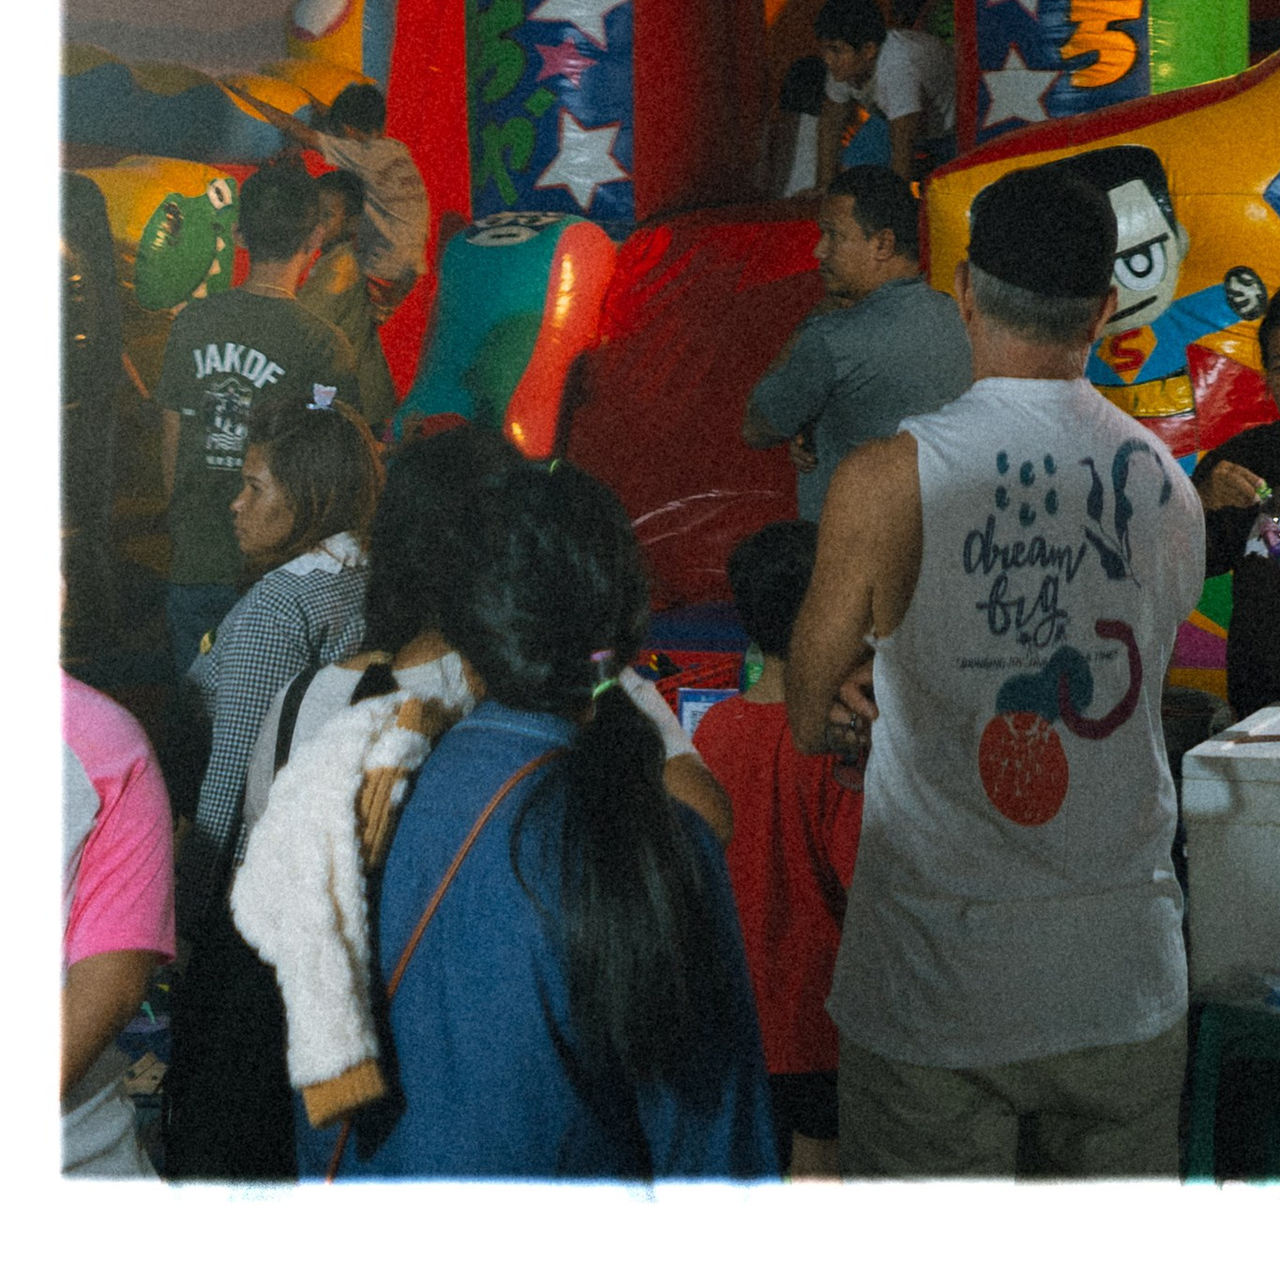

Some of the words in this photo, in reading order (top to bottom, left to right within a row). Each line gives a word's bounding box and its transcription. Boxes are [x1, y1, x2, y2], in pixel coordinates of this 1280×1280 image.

[1110, 327, 1145, 374] S
[961, 513, 1088, 585] dream
[975, 569, 1070, 648] big
